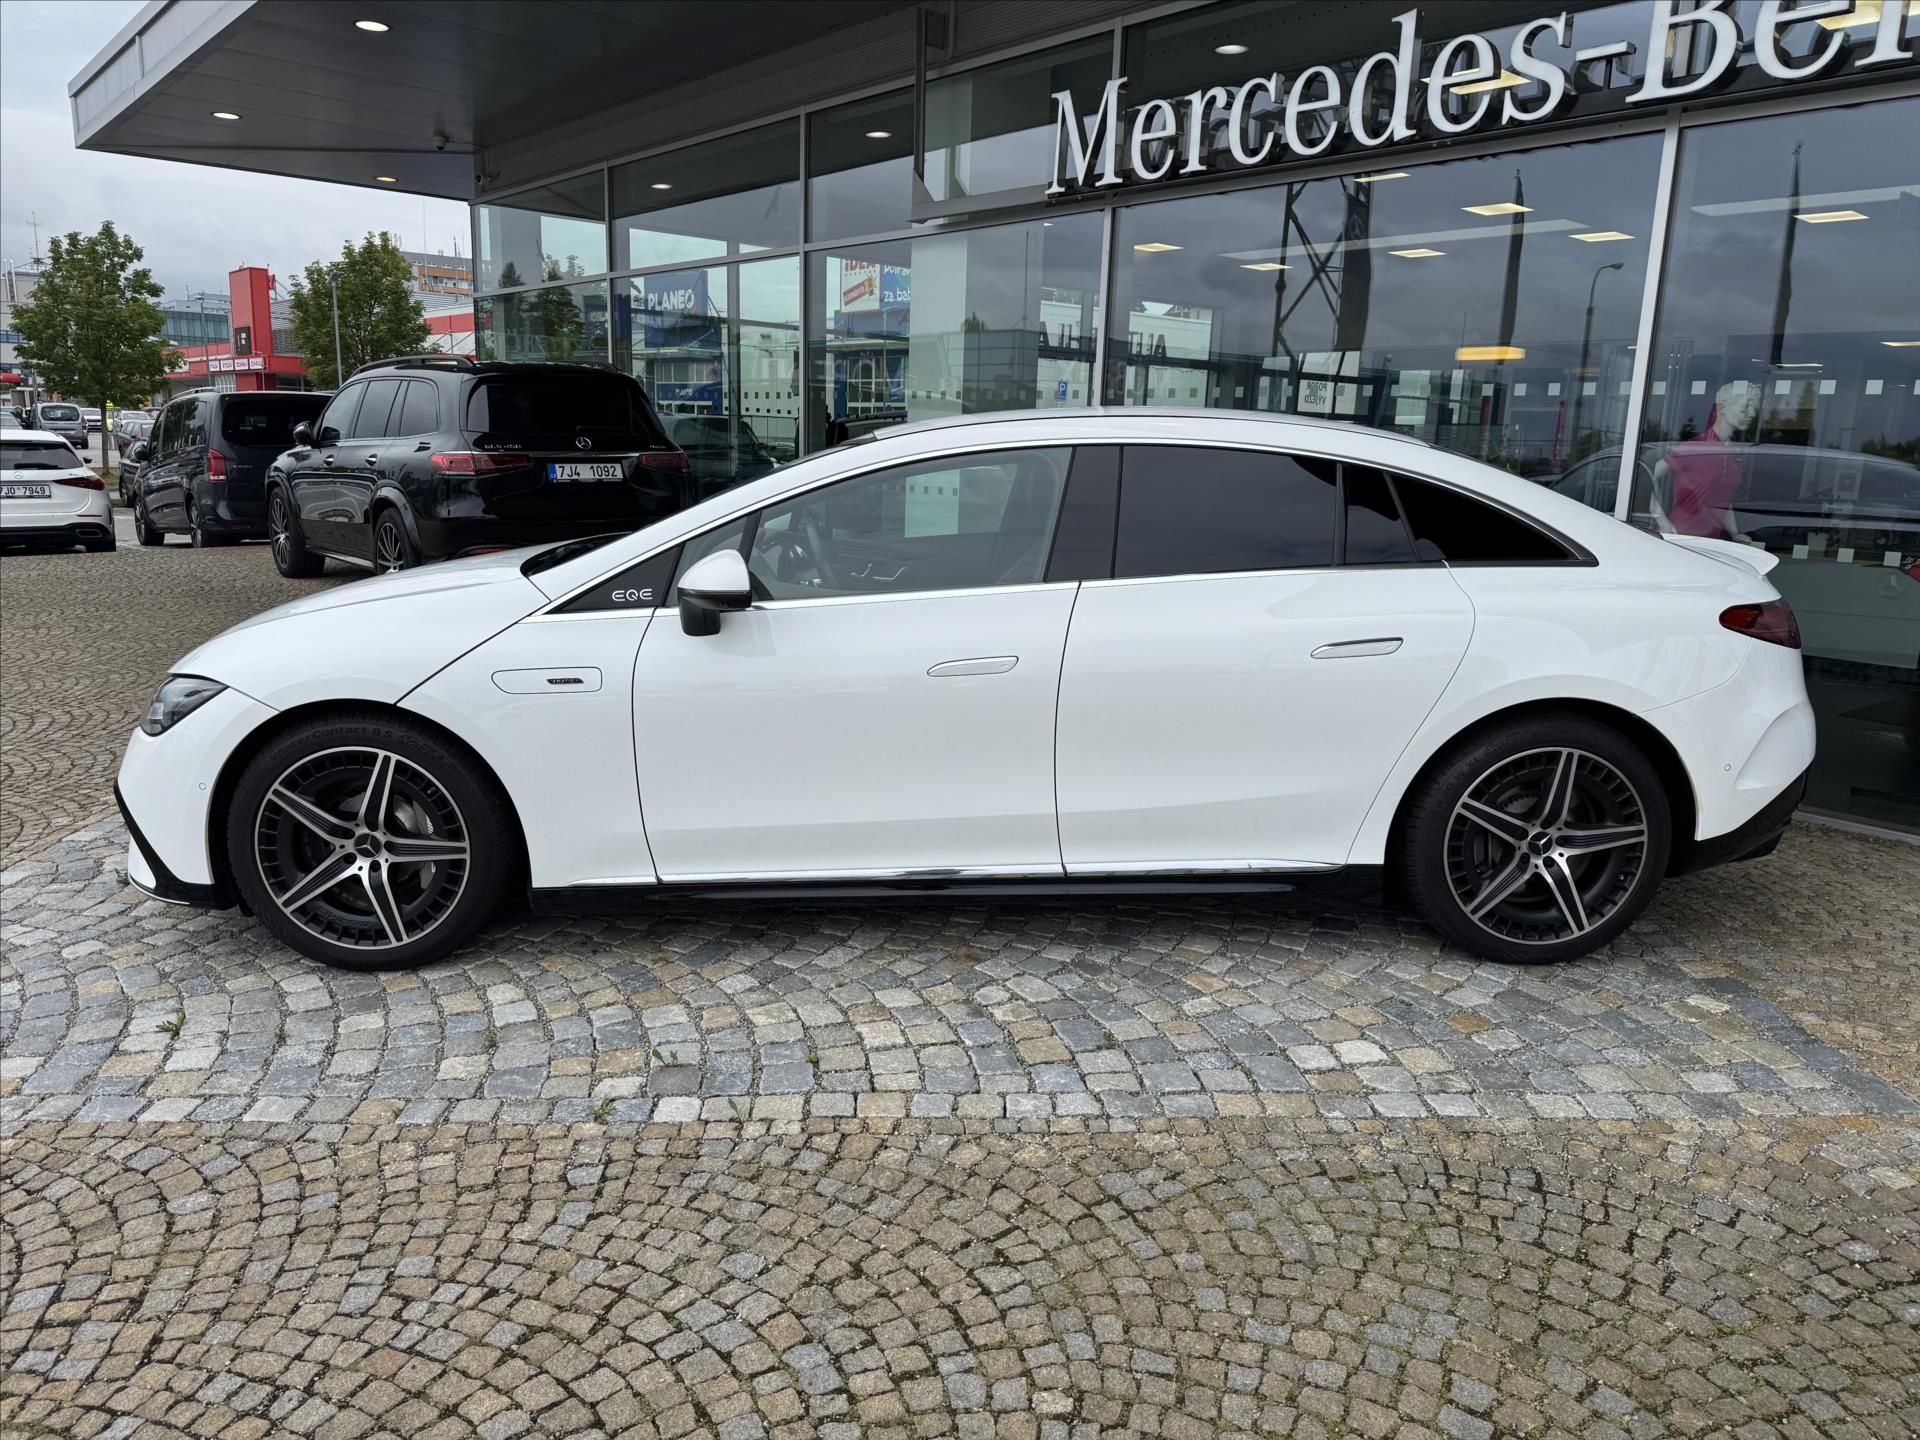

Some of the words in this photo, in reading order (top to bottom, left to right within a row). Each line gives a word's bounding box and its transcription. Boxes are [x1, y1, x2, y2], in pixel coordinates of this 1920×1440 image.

[1045, 0, 1920, 195] Mercedes-Be
[648, 289, 695, 311] PLANEO
[883, 290, 894, 302] za
[558, 466, 580, 478] 7J4
[590, 465, 618, 478] 1092
[22, 486, 46, 495] 7949
[612, 588, 653, 601] EQE
